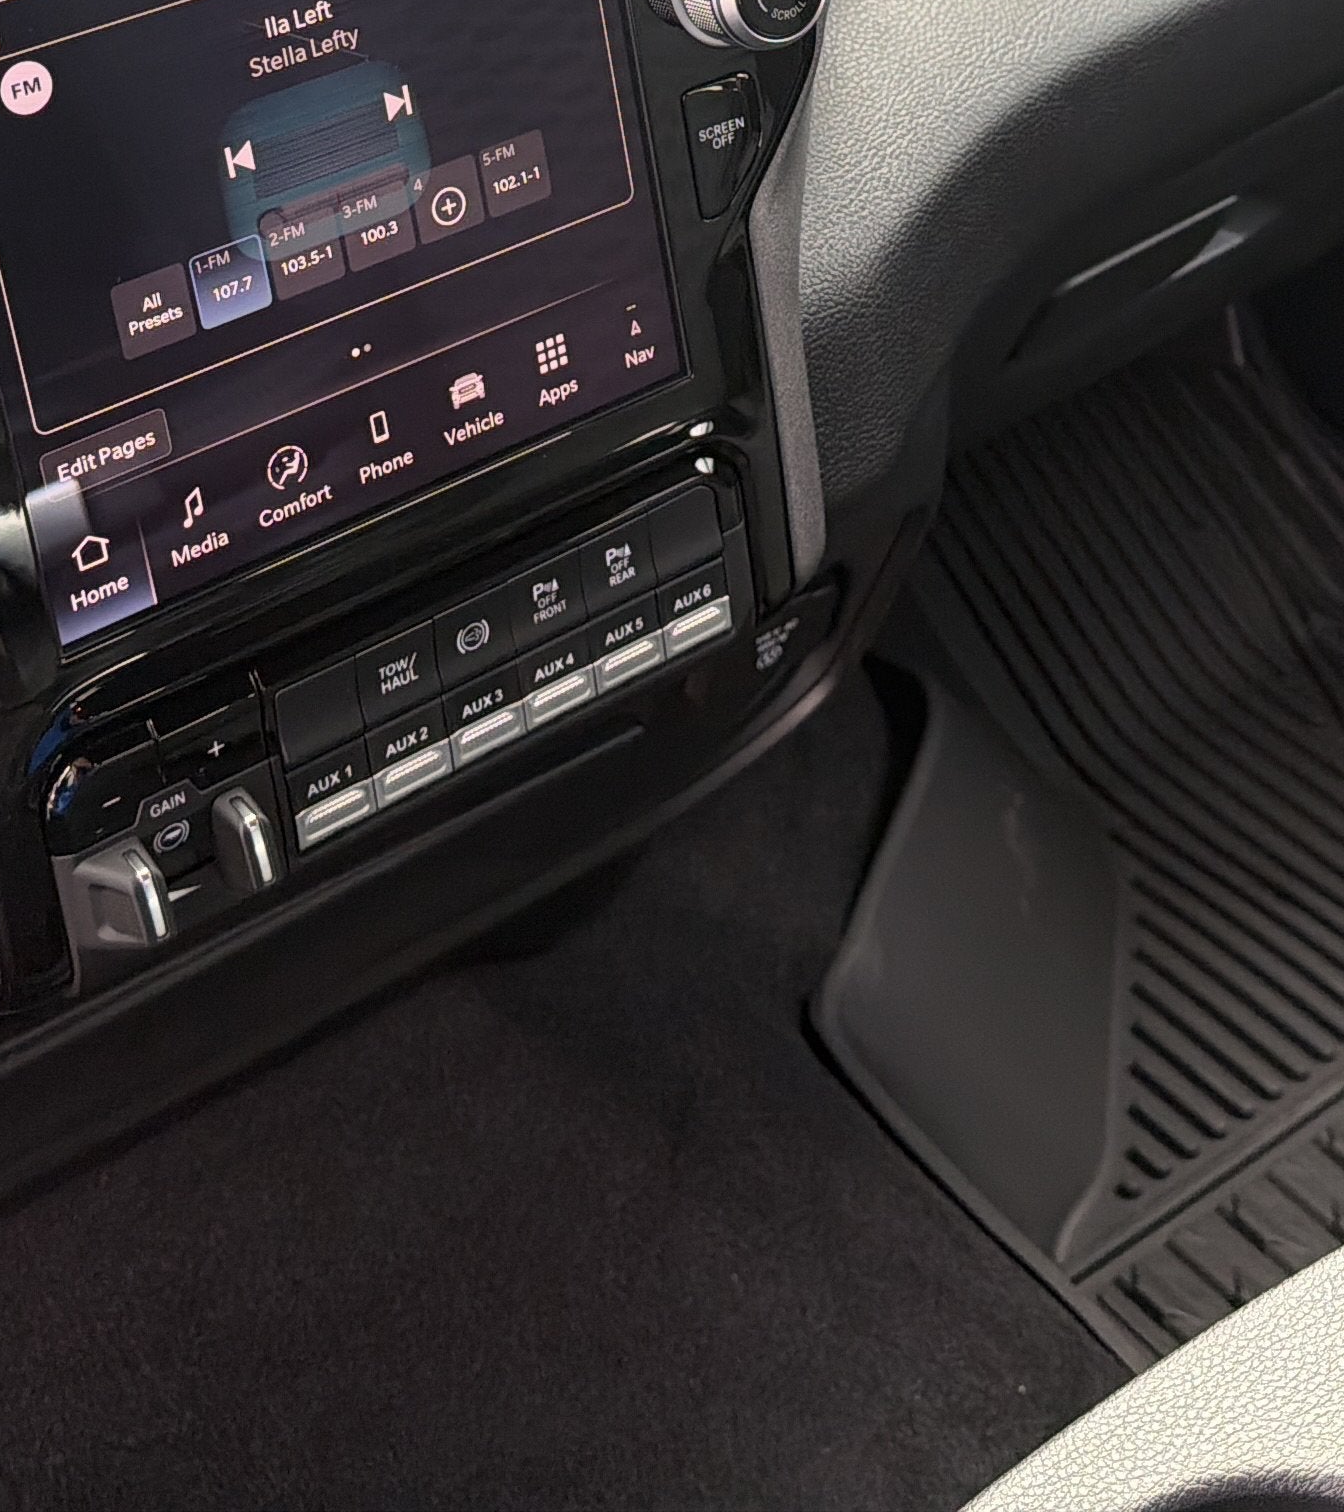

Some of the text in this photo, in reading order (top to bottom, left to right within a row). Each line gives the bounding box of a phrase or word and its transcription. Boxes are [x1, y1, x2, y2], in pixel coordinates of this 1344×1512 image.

[293, 0, 333, 29] Left
[771, 1, 806, 20] SCROLL
[249, 28, 359, 78] Stella Lefty
[10, 76, 42, 99] FM
[698, 117, 745, 143] SCREEN
[712, 132, 735, 150] OFF
[482, 144, 516, 167] 5-FM
[492, 166, 542, 195] 102.1-1
[342, 195, 378, 219] 3-FM
[268, 222, 305, 248] 2-FM
[360, 220, 399, 246] 100.3
[195, 251, 230, 275] 1-FM
[281, 245, 334, 276] 103.5-1
[142, 292, 162, 313] All
[212, 276, 254, 303] 107.7
[128, 304, 183, 336] Presets
[625, 346, 655, 368] Nav
[538, 378, 579, 408] Apps
[444, 411, 504, 447] Vehicle
[56, 430, 157, 485] Edit Pages
[358, 449, 415, 485] Phone
[258, 485, 333, 528] Comfort
[171, 529, 230, 568] Media
[609, 566, 636, 587] REAR
[610, 558, 630, 573] OFF
[70, 574, 130, 612] Home
[538, 592, 557, 608] OFF
[673, 584, 712, 612] AUX 6
[533, 599, 567, 624] FRONT
[605, 616, 645, 646] AUX 5
[379, 652, 418, 682] TOW/
[380, 666, 419, 695] HAUL
[534, 653, 574, 683] AUX 4
[461, 689, 504, 720] AUX 3
[385, 726, 429, 759] AUX 2
[307, 765, 353, 799] AUX 1
[150, 791, 186, 817] GAIN
